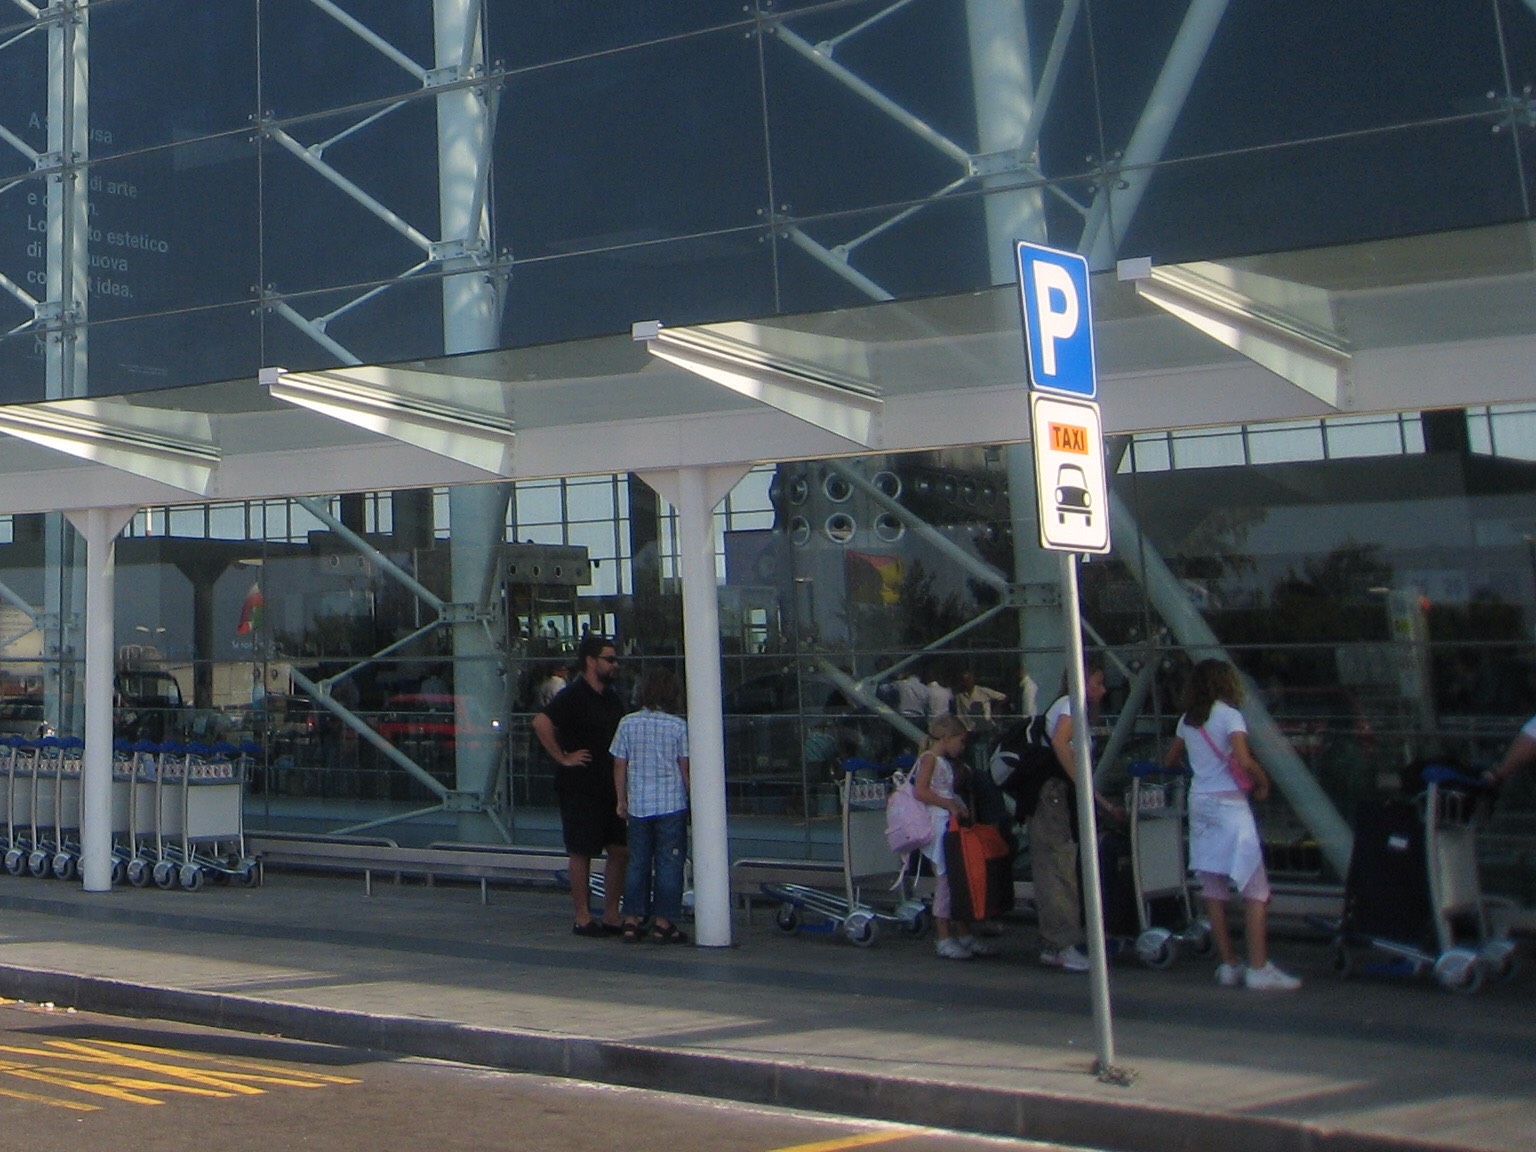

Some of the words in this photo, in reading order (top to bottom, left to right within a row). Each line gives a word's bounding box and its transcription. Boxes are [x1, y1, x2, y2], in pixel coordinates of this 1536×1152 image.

[28, 112, 40, 129] A
[27, 193, 37, 206] e
[107, 180, 138, 198] arte
[107, 230, 169, 253] estetico
[27, 241, 42, 258] di
[89, 255, 129, 272] uova
[97, 277, 134, 298] idea.
[1032, 259, 1078, 376] P
[1052, 426, 1085, 452] TAXI
